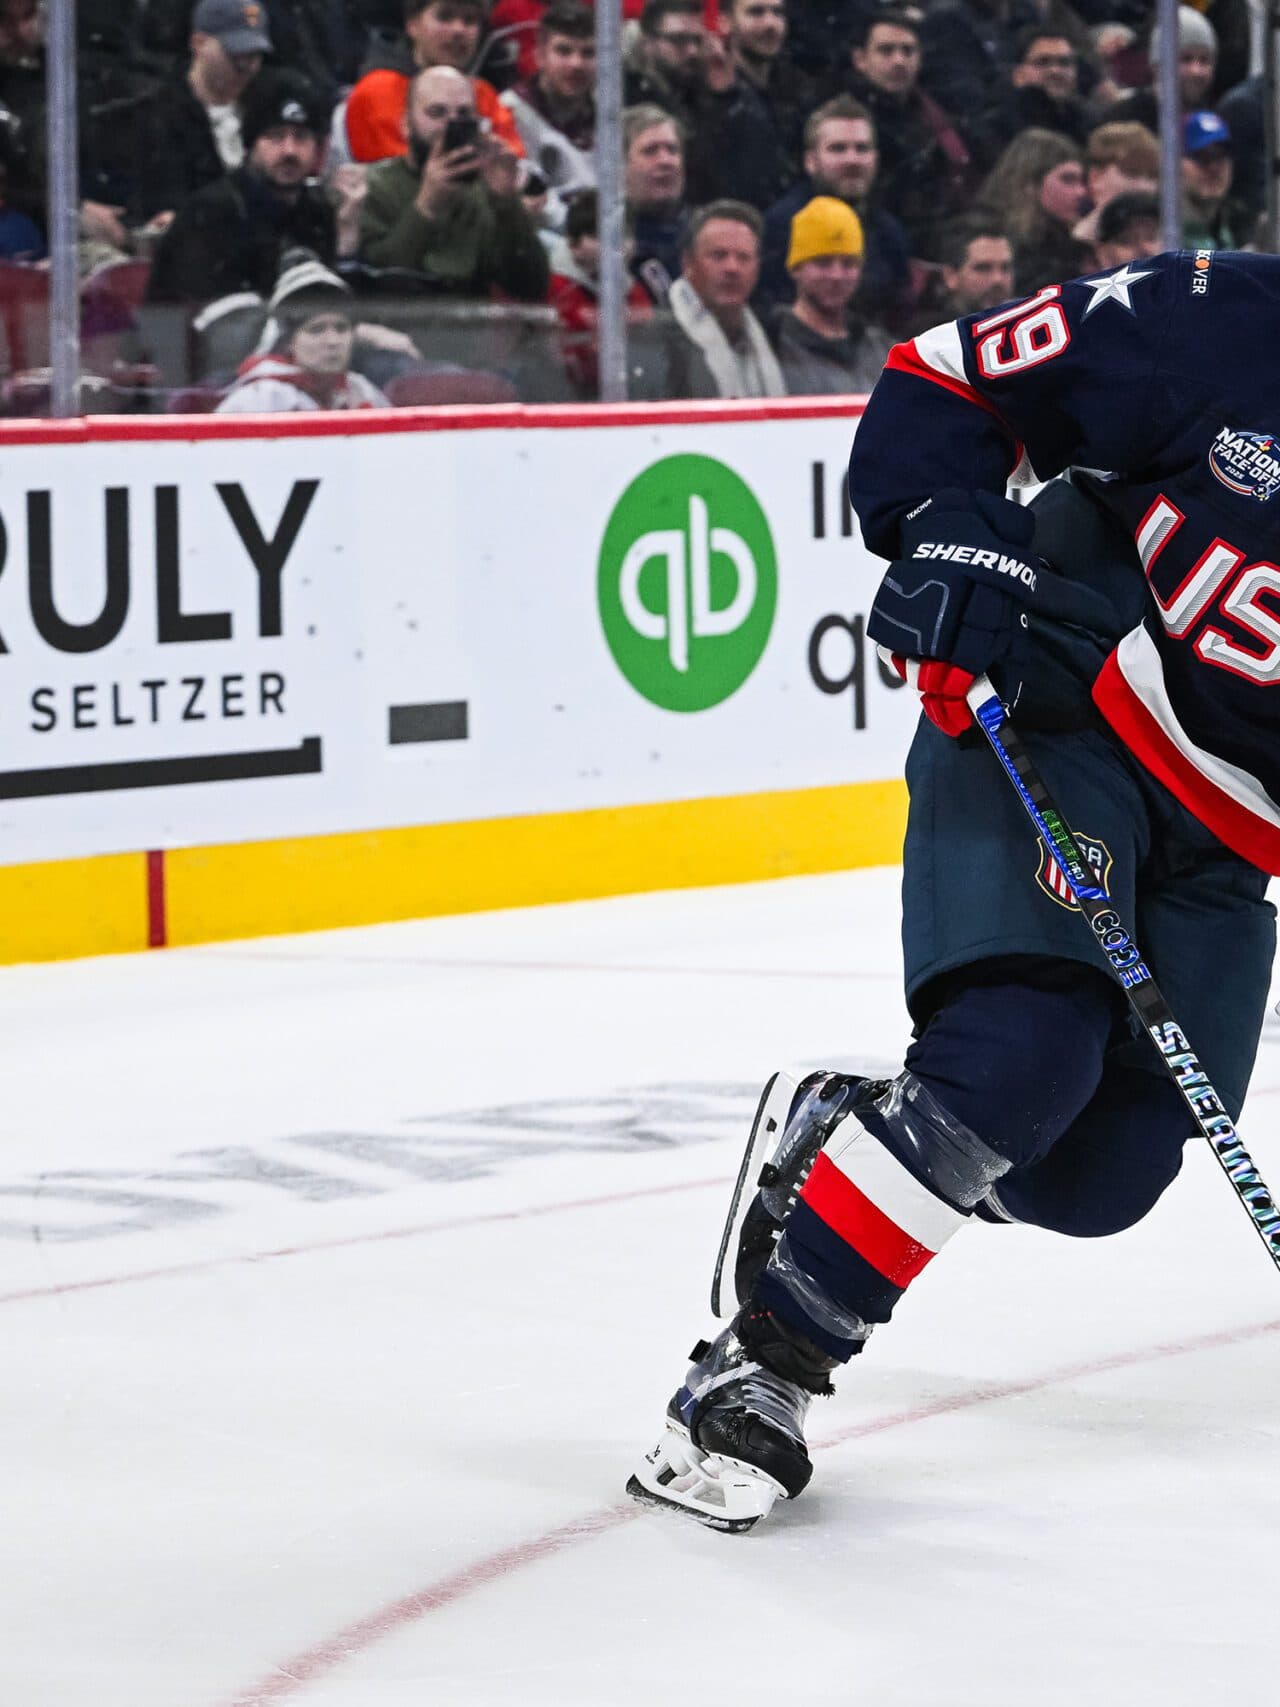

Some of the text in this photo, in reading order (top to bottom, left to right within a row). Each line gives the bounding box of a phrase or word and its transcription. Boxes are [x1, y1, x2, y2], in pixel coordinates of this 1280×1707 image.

[973, 285, 1071, 379] 19
[31, 672, 286, 733] SELTZER
[1069, 860, 1085, 880] PRO
[1091, 909, 1152, 989] CODE
